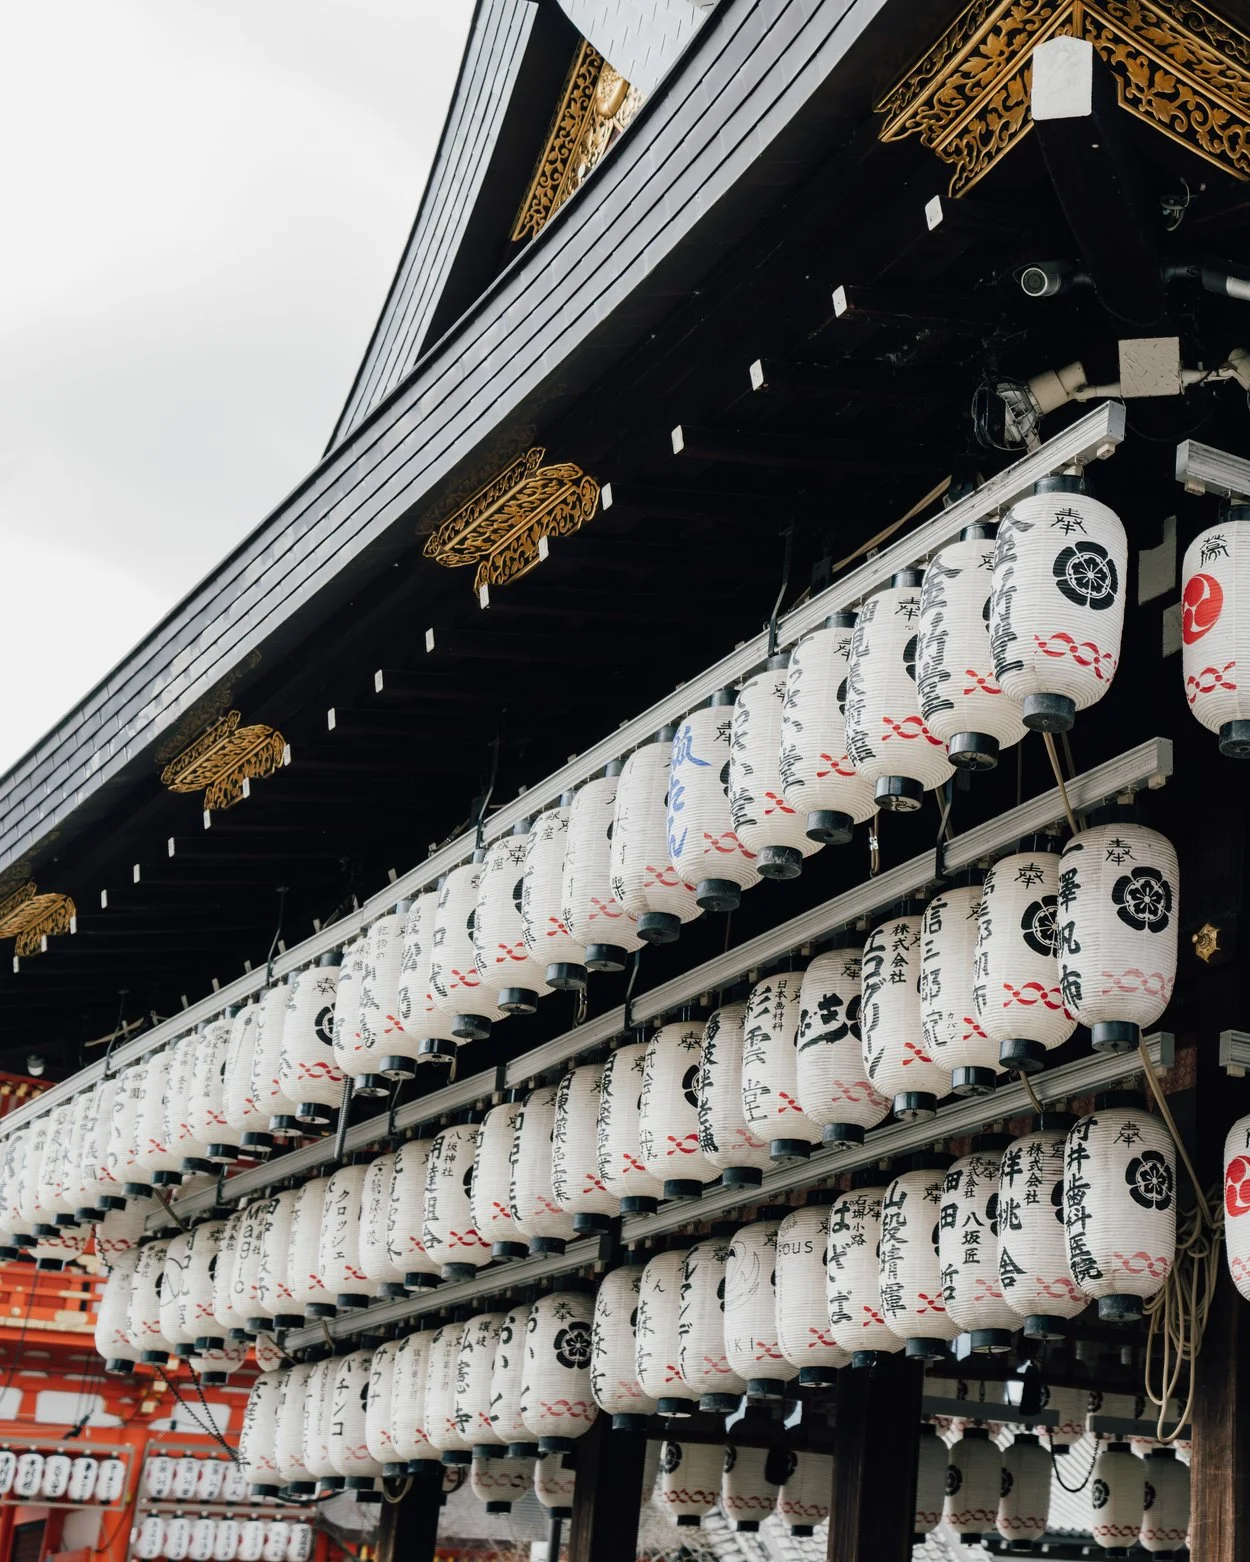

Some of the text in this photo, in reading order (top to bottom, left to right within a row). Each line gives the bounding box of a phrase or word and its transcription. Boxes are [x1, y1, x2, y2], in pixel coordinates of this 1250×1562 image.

[1051, 508, 1088, 535] 奉
[1106, 838, 1137, 866] 奉
[1014, 863, 1045, 889] 奉
[890, 922, 911, 986] 株式会社
[770, 979, 788, 1032] 日本画材料
[442, 1131, 462, 1177] 八坂神社
[1114, 1121, 1145, 1148] 奉
[963, 1156, 983, 1199] 株式会社
[1024, 1142, 1045, 1204] 株式会社
[332, 1189, 351, 1260] クロッシェ
[850, 1194, 867, 1246] 石塀小路
[961, 1211, 985, 1265] 八坂匠
[553, 1302, 576, 1322] 奉
